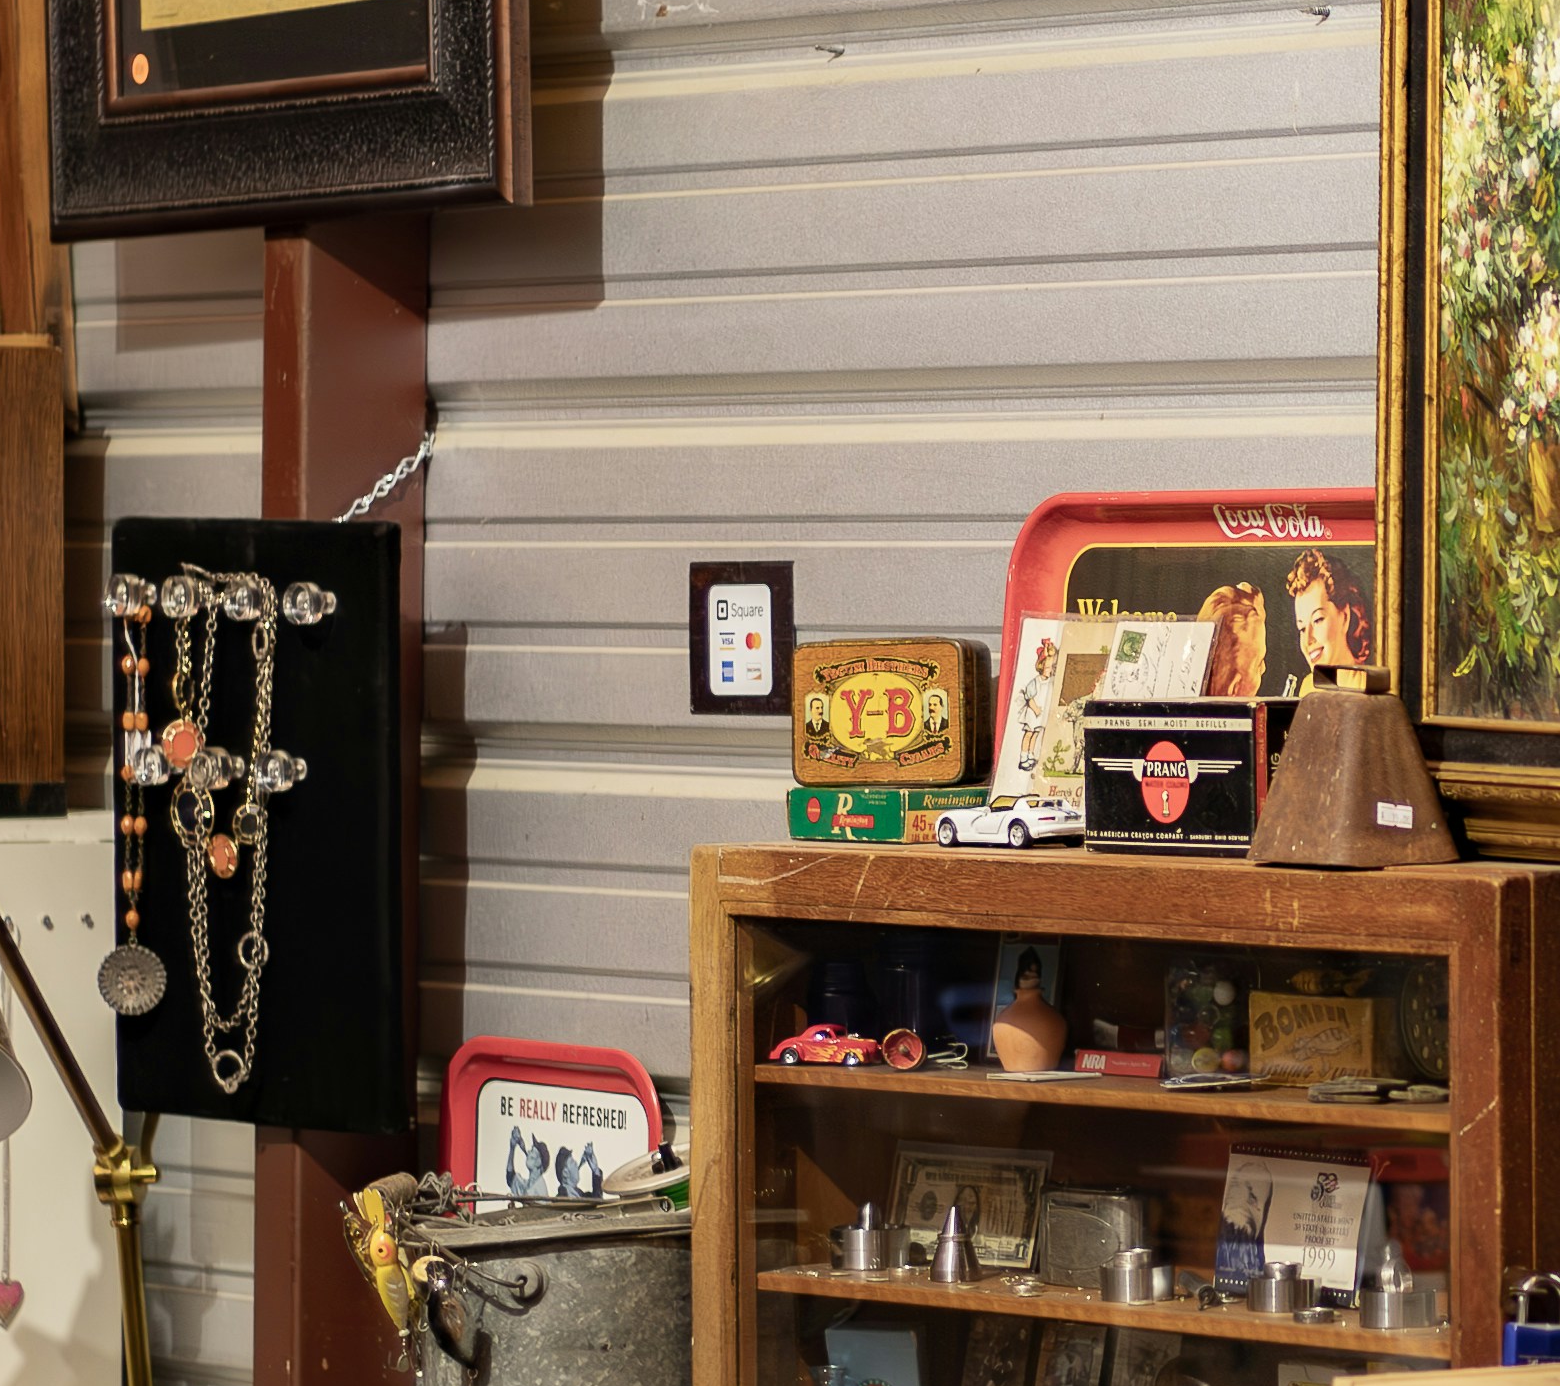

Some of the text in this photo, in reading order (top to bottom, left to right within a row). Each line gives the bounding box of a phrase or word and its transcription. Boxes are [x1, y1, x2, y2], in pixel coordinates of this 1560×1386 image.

[730, 602, 764, 621] Square
[840, 688, 915, 739] Y-B
[1104, 719, 1228, 729] PRANG SEMI MOIST REFILLS
[923, 793, 983, 809] Remington
[911, 814, 927, 832] 45
[1099, 830, 1129, 840] AMERICAN
[1081, 1052, 1106, 1071] NRA
[500, 1096, 628, 1131] BE REALLY REFRESHED!
[1302, 1245, 1337, 1271] 1999
